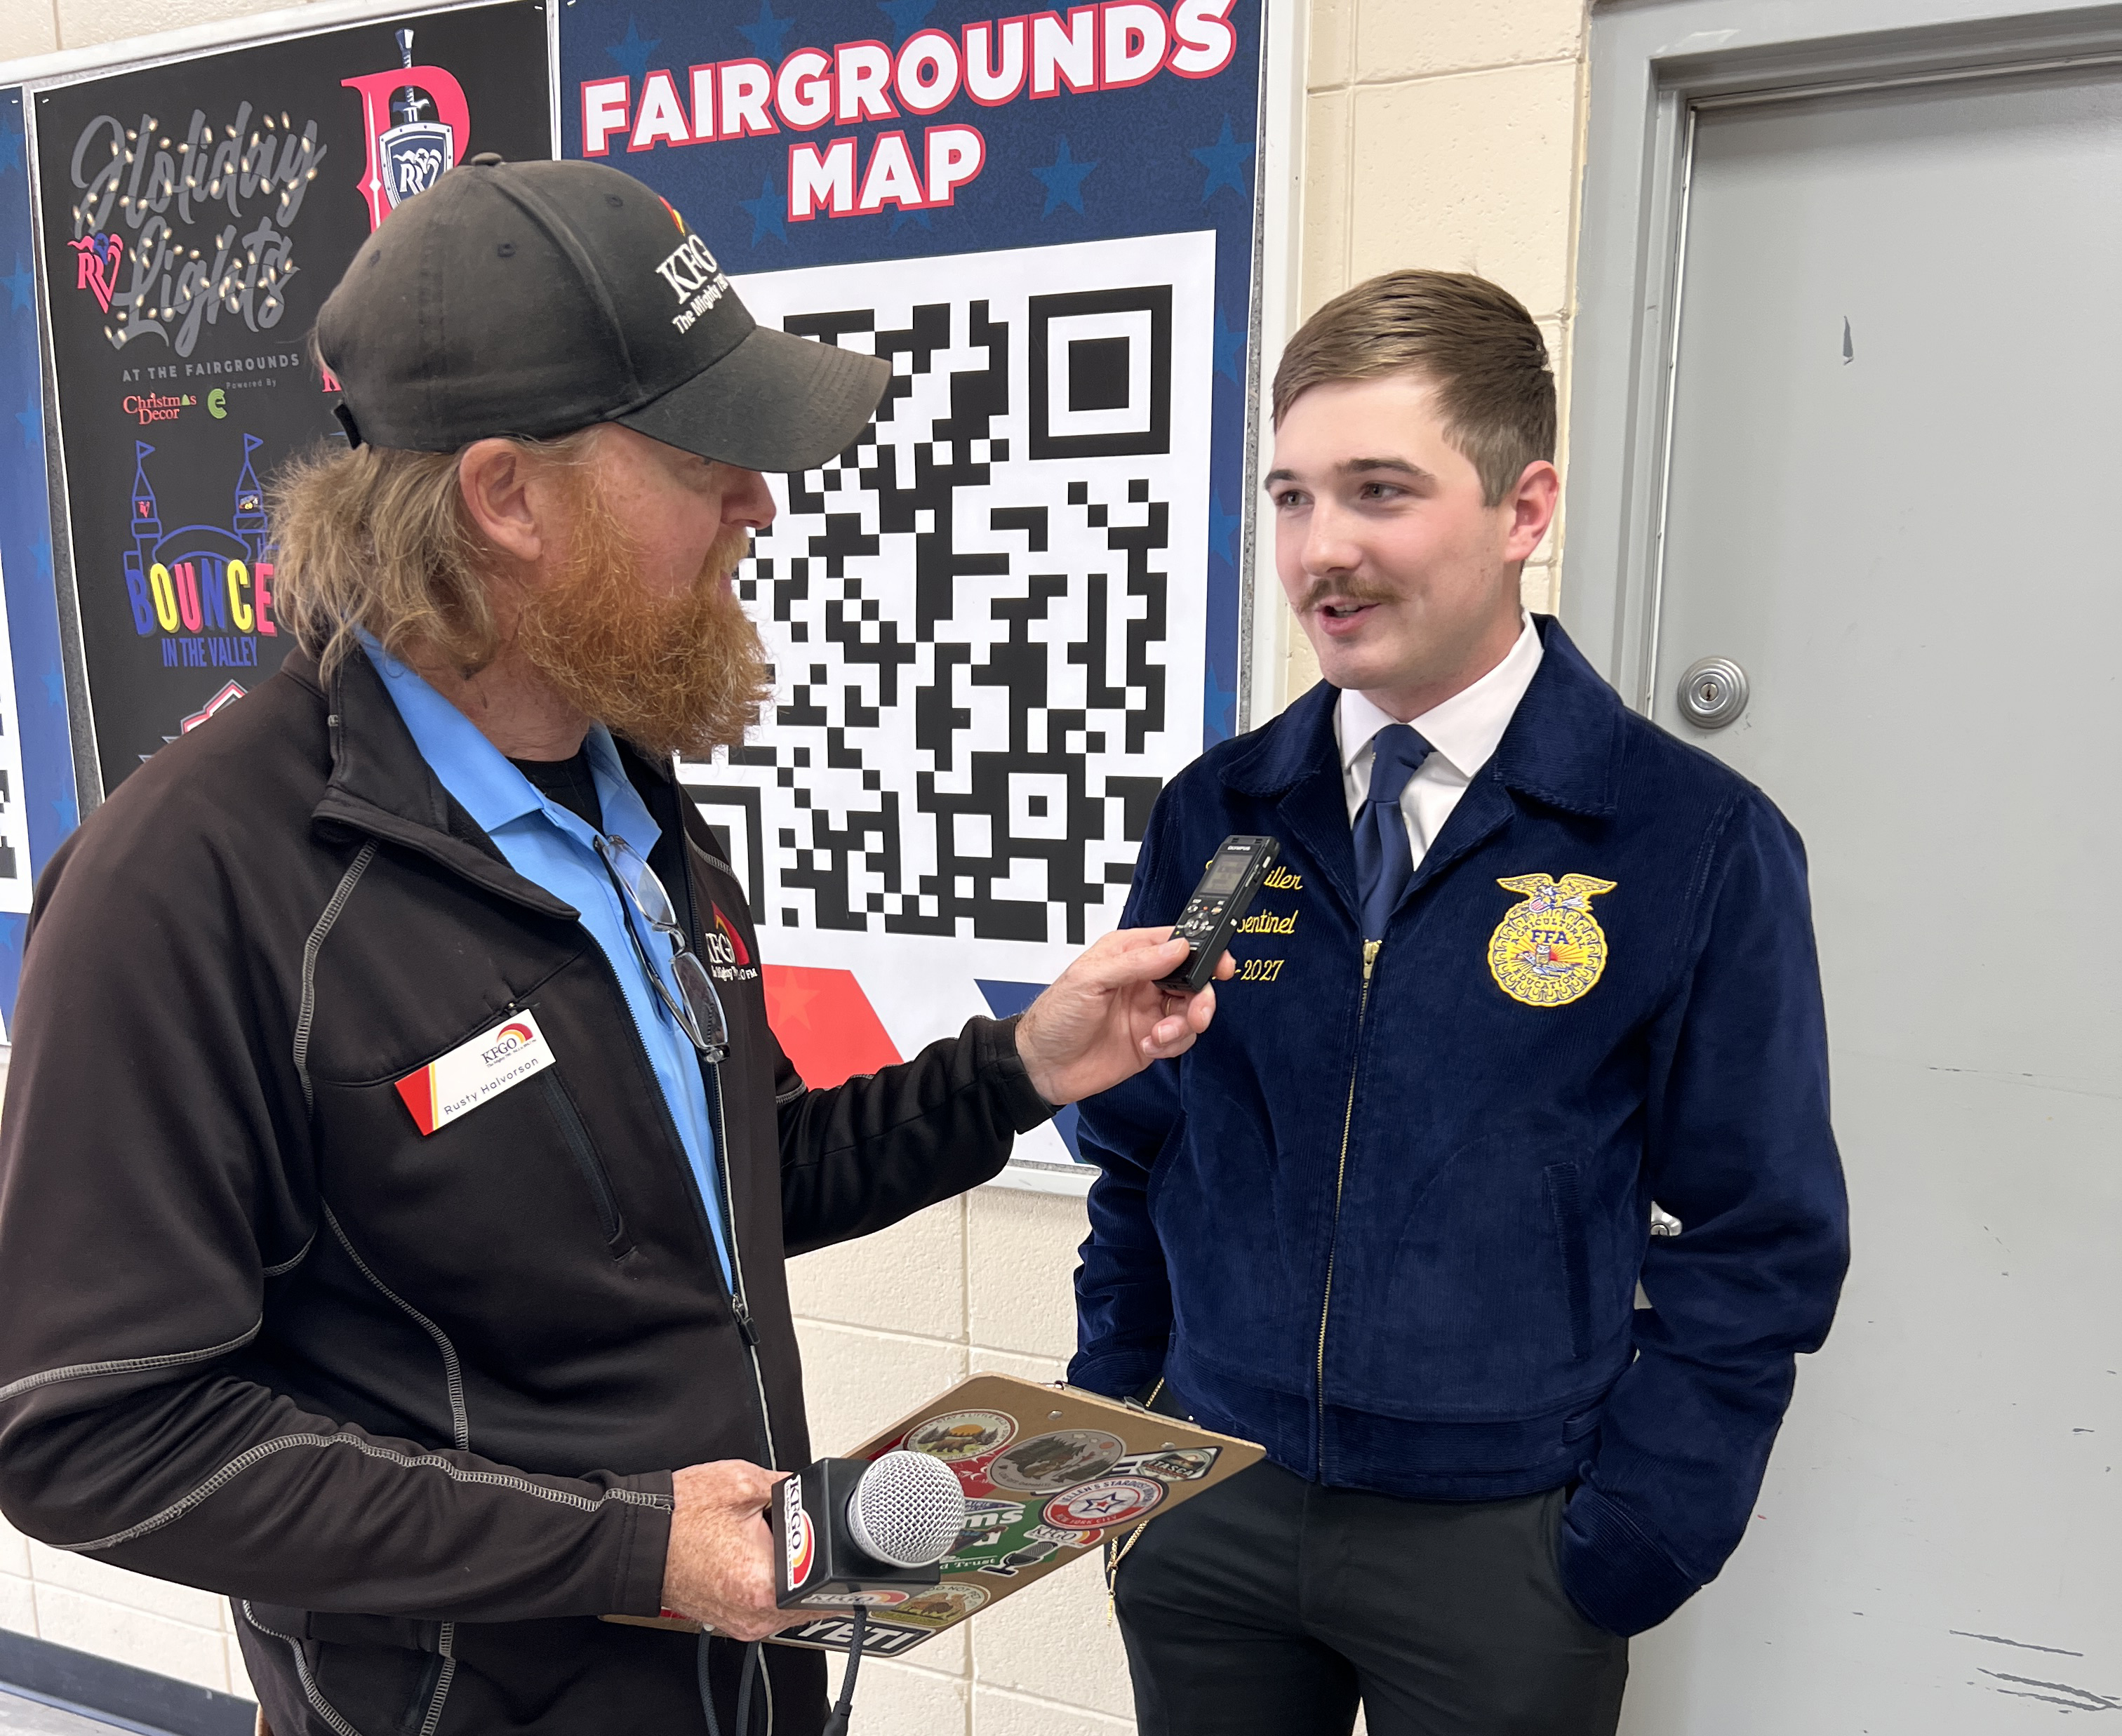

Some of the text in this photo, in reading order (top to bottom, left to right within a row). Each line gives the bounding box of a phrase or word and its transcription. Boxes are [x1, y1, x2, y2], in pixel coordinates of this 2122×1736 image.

[580, 0, 1238, 159] FAIRGROUNDS
[70, 101, 327, 239] Holiday
[787, 123, 985, 222] MAP
[655, 234, 718, 305] KFG
[112, 215, 300, 357] Lights
[672, 310, 696, 334] The
[690, 283, 722, 316] Mighty
[122, 353, 300, 382] AT THE FAIRGROUNDS
[226, 380, 262, 389] Powered
[138, 407, 180, 425] Decor
[124, 559, 278, 639] BOUNCE
[161, 636, 258, 667] IN THE VALLEY
[1264, 866, 1302, 890] iller
[1511, 918, 1586, 949] AGRICULTURAL
[1530, 930, 1569, 944] FFA
[1234, 959, 1285, 981] -2027
[1514, 968, 1578, 989] EDUCATION
[481, 1038, 517, 1064] KFGO
[444, 1057, 539, 1114] Rusty Halvorson
[1154, 1460, 1194, 1477] ITASCA
[1062, 1483, 1100, 1502] ELLEN'S
[789, 1482, 801, 1549] KFGO
[1032, 1526, 1076, 1541] KFGO
[954, 1558, 996, 1568] Trust
[798, 1620, 913, 1649] YETI
